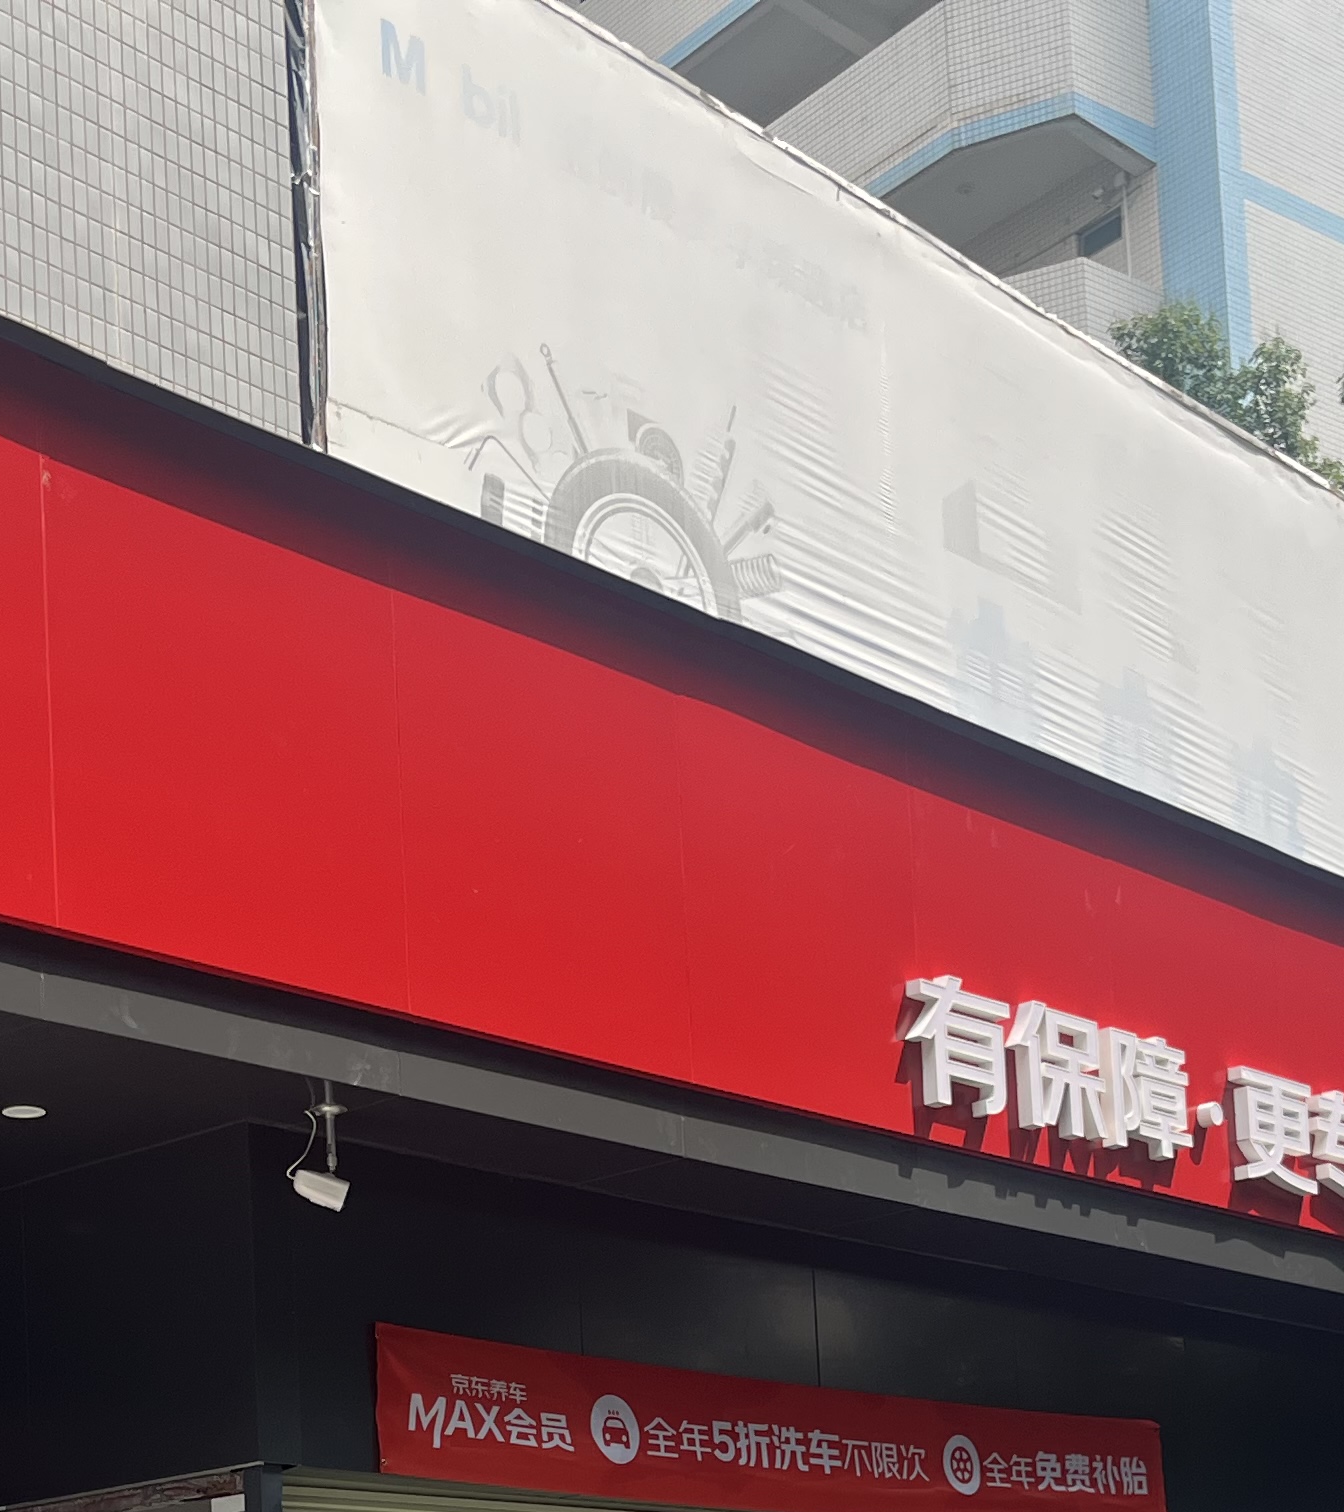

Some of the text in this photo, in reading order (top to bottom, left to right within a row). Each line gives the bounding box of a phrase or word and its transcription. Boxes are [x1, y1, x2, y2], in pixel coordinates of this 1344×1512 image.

[449, 1373, 528, 1404] 京东养车
[407, 1392, 1149, 1496] MAX会员 全年5折洗车不限次 全年免费补胎
